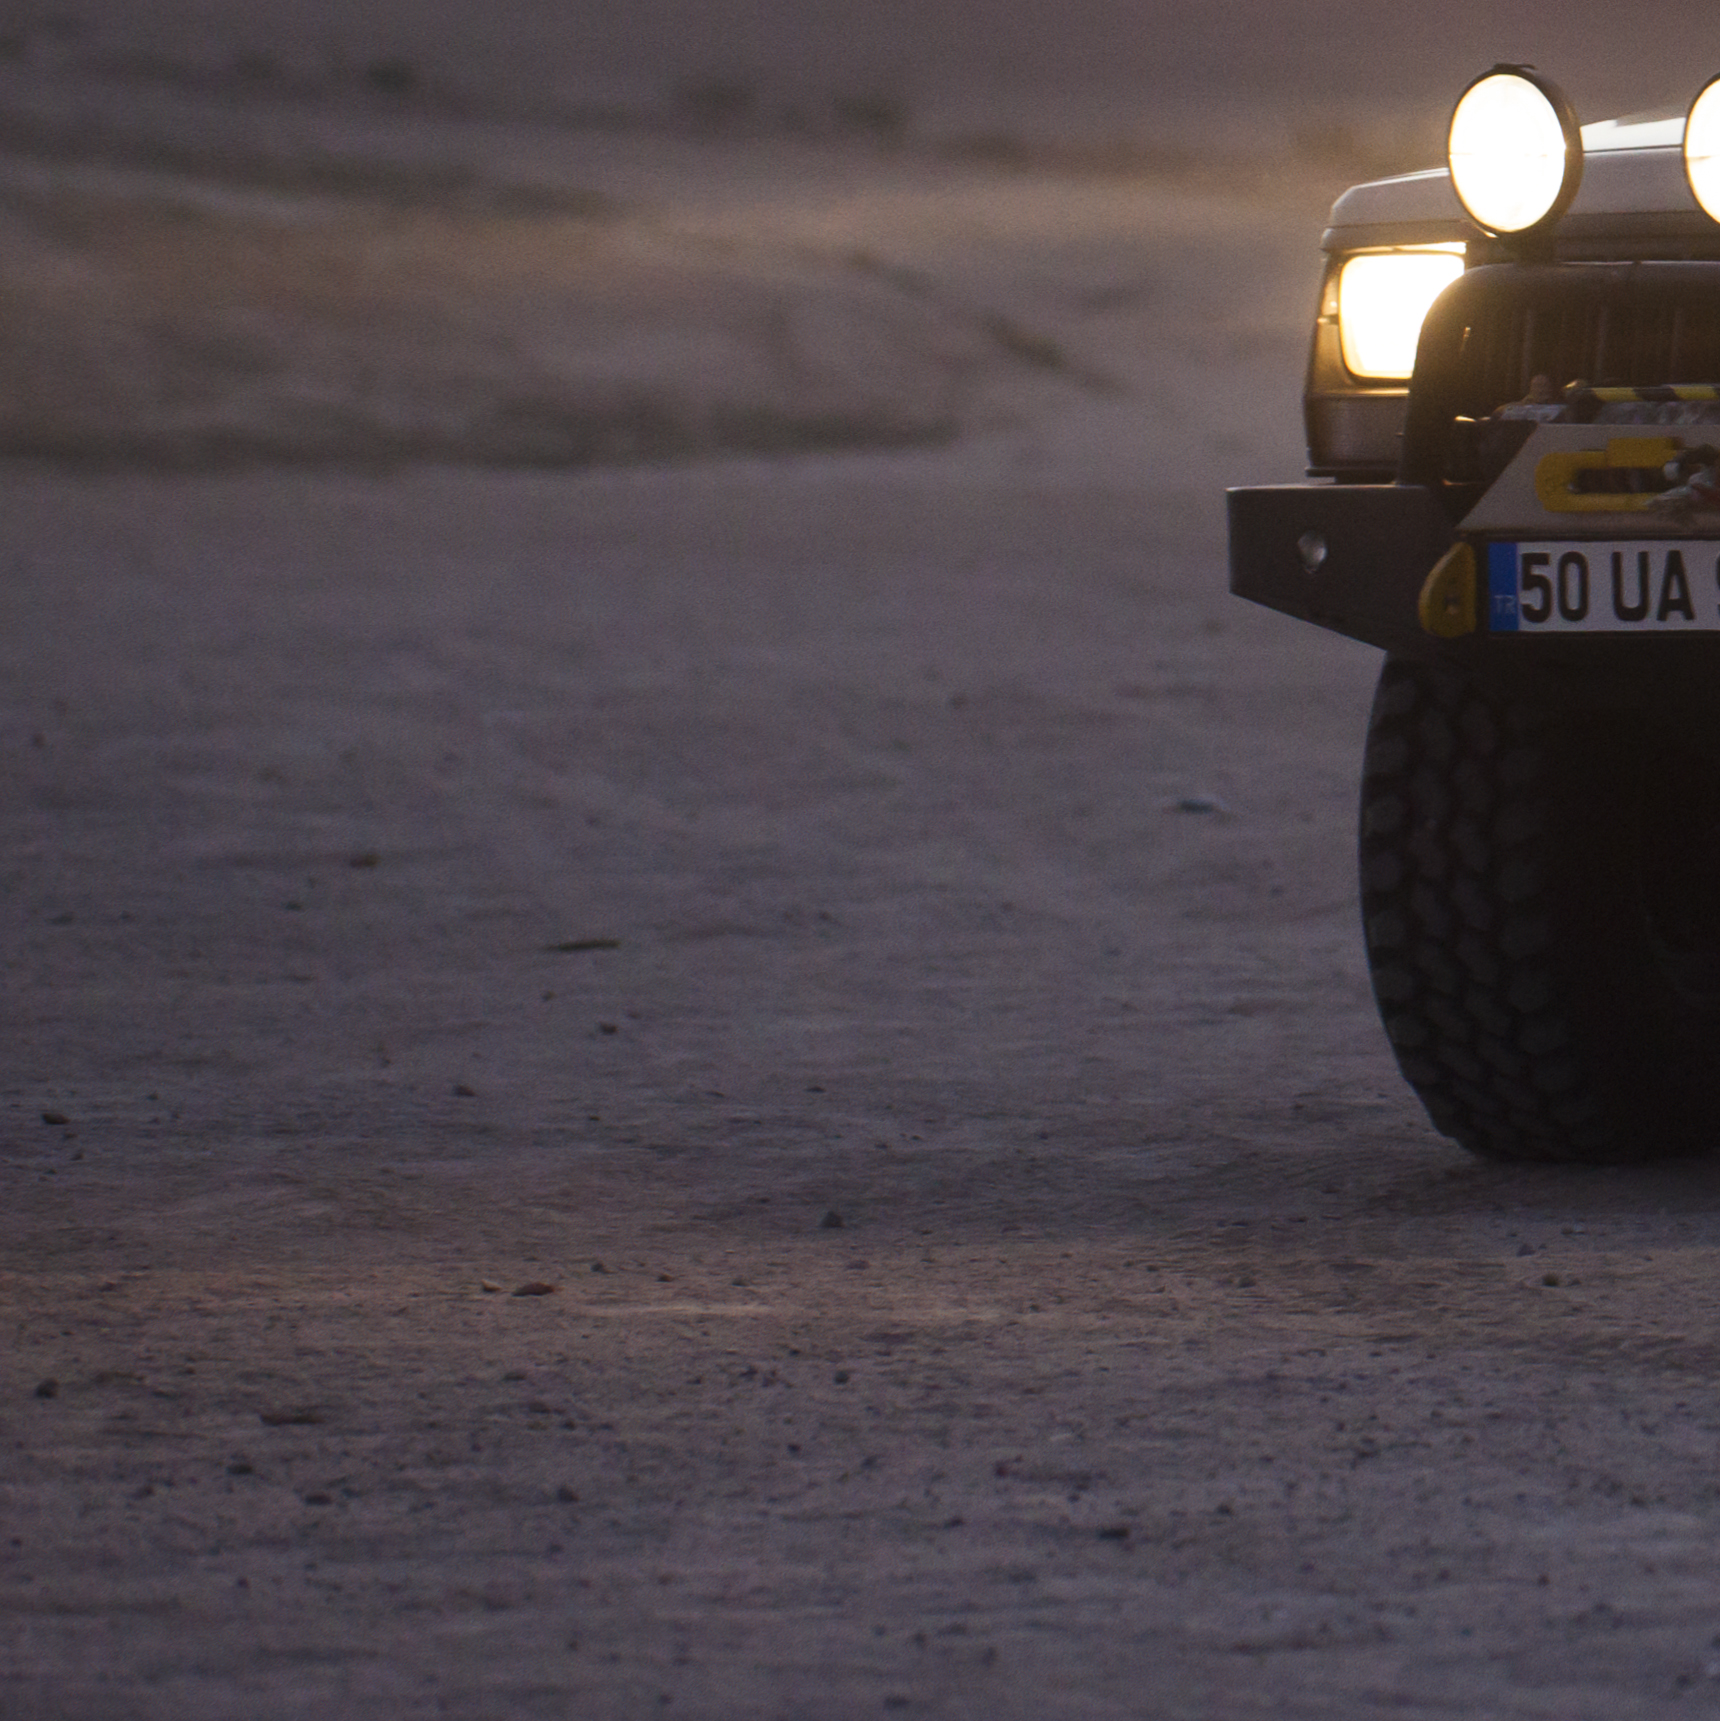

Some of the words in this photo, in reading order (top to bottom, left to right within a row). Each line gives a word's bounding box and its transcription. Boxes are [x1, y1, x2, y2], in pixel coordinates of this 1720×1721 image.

[1493, 593, 1517, 615] TR
[1521, 550, 1590, 623] 50
[1610, 550, 1695, 623] UA
